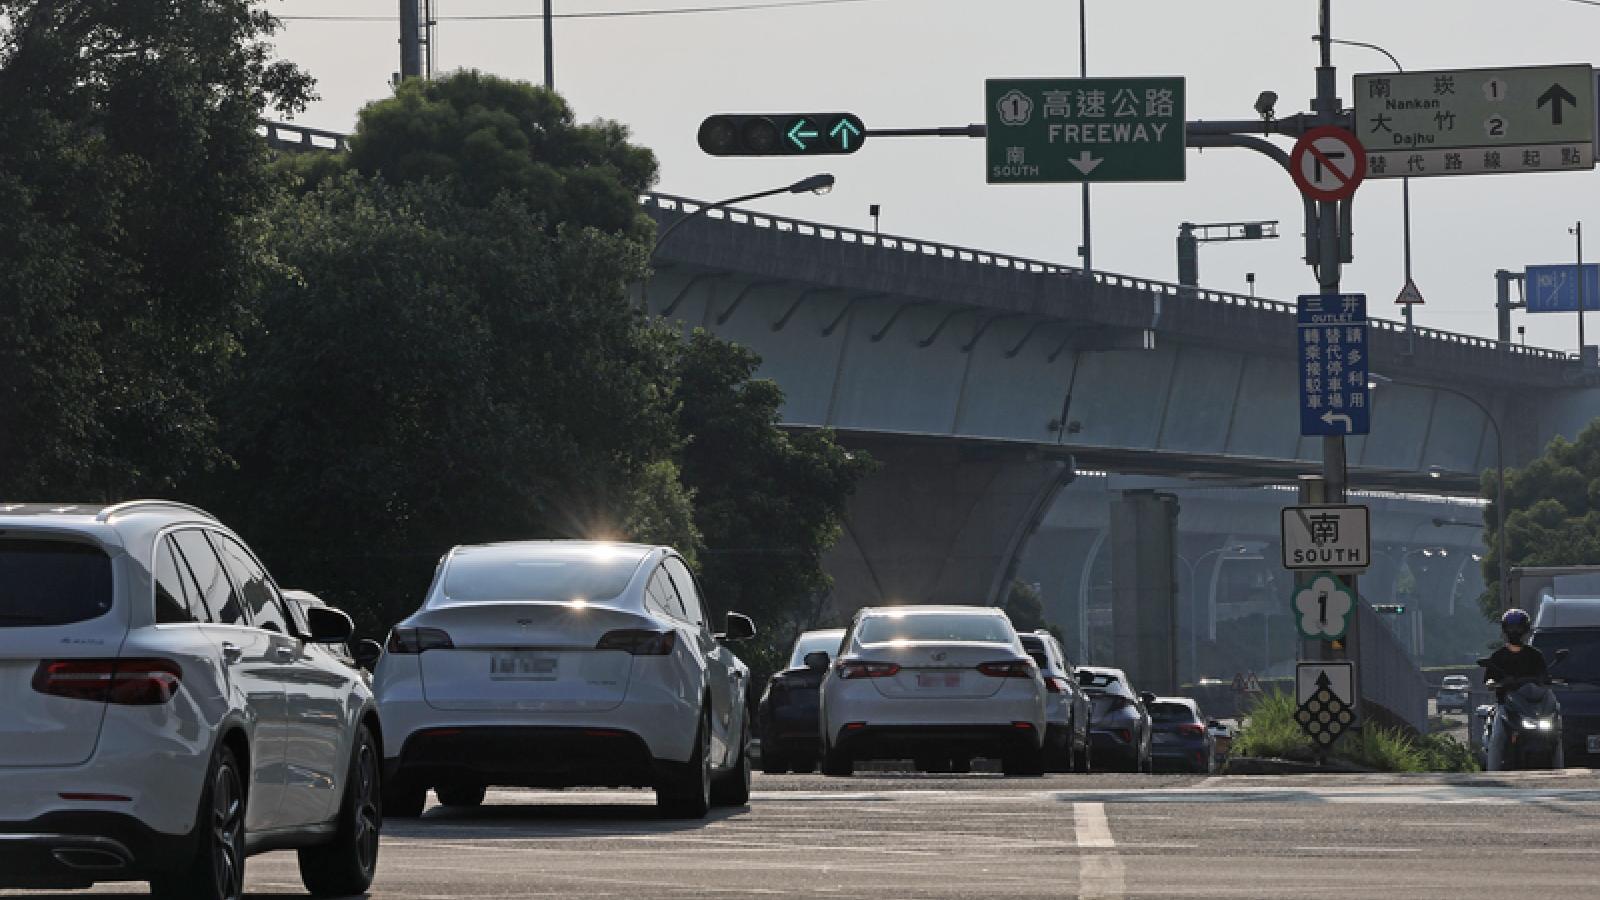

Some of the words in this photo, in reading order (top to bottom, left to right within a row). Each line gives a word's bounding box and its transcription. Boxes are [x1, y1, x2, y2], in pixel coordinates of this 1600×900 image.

[1368, 77, 1455, 97] 南崁
[1488, 81, 1498, 98] 1
[1043, 89, 1173, 118] 高速公路
[1386, 98, 1440, 110] Nankan
[1370, 110, 1457, 133] 大竹
[1489, 118, 1504, 136] 2
[1049, 123, 1168, 144] FREEWAY
[1393, 132, 1435, 147] Dajhu
[1007, 146, 1025, 164] 南
[1369, 149, 1581, 173] 替代路線起點
[994, 165, 1039, 177] SOUTH
[1305, 296, 1359, 312] 三井
[1311, 314, 1353, 323] OUTLET
[1325, 328, 1343, 408] 替代停車場
[1346, 327, 1365, 407] 請多利用
[1309, 512, 1341, 544] 南
[1293, 548, 1360, 563] SOUTH
[1317, 592, 1328, 625] 1
